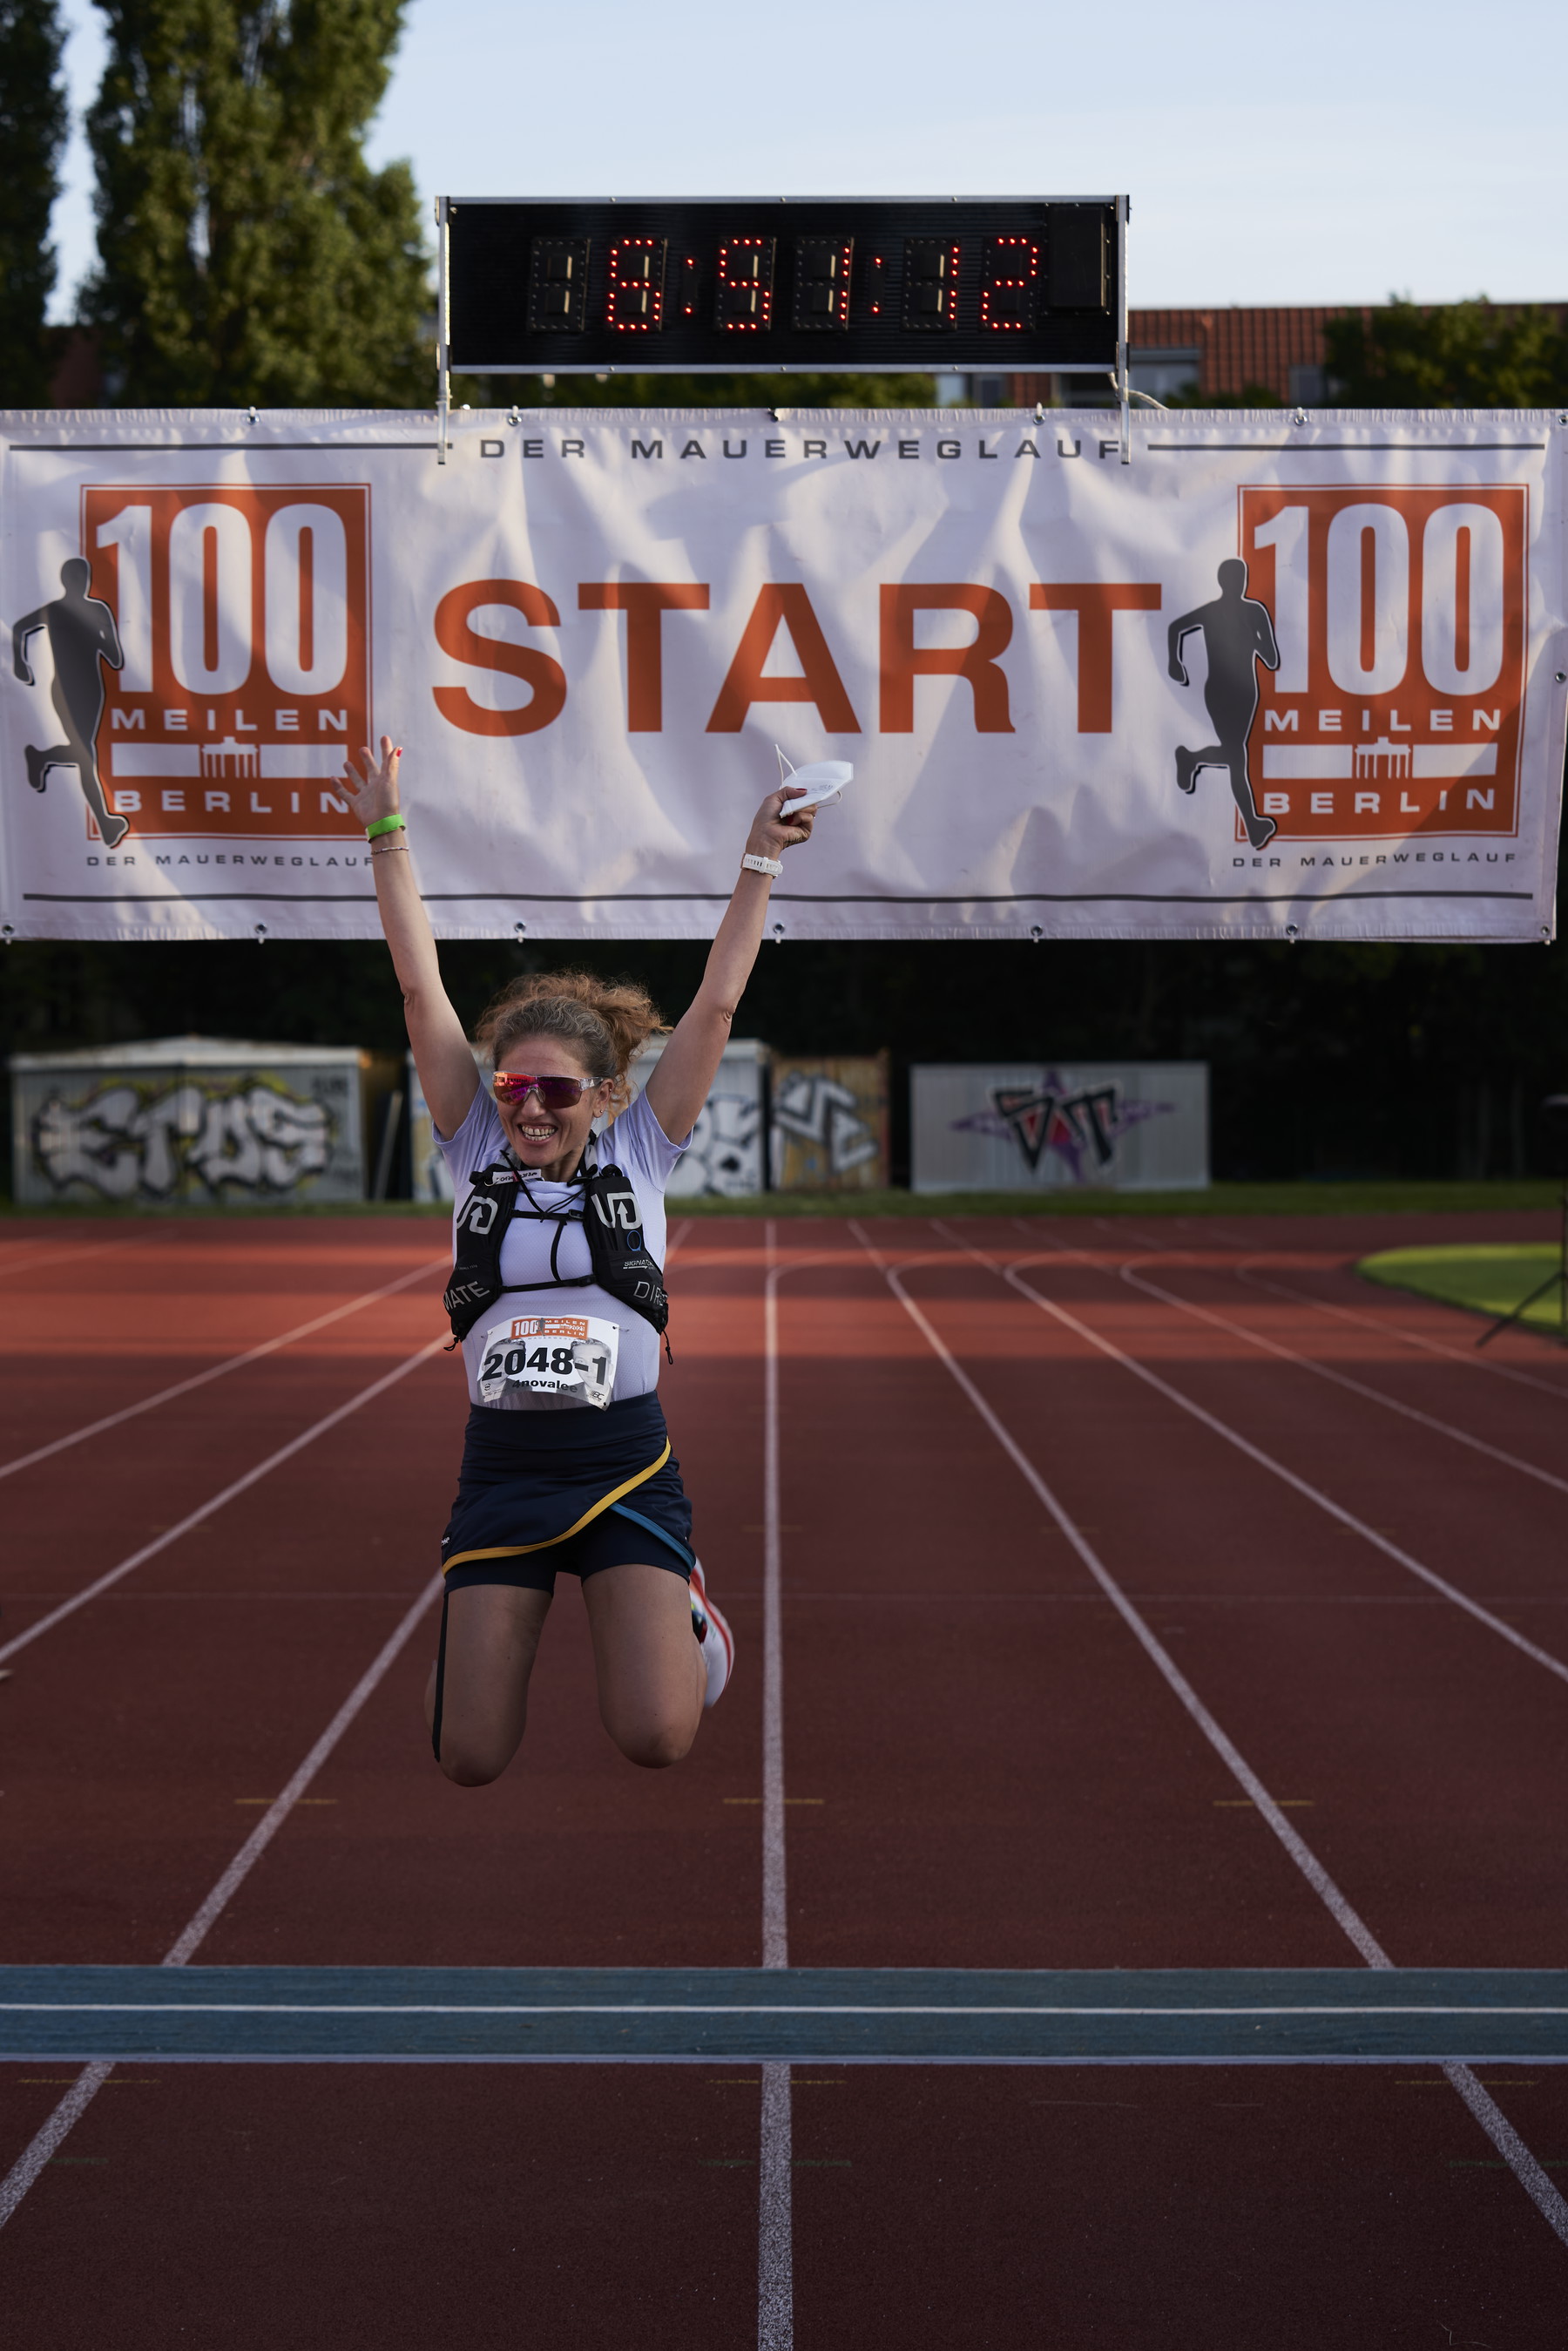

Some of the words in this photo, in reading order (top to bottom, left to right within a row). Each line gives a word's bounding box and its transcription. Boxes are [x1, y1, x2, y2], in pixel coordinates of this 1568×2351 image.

[481, 439, 585, 459] DER
[632, 439, 1119, 460] MAUERWEGLAUF
[96, 502, 347, 695] 100
[1254, 502, 1504, 695] 100
[432, 579, 1162, 737] START
[112, 708, 348, 731] MEILEN
[1264, 708, 1501, 732] MEILEN
[114, 789, 349, 814] BERLIN
[1263, 788, 1495, 814] BERLIN
[87, 856, 137, 866] DER
[156, 853, 373, 867] MAUERWEGLAUF
[1233, 857, 1282, 867] DER
[1301, 851, 1517, 867] MAUERWEGLAUF
[481, 1347, 607, 1386] 2048-1
[511, 1379, 578, 1393] 4novalee
